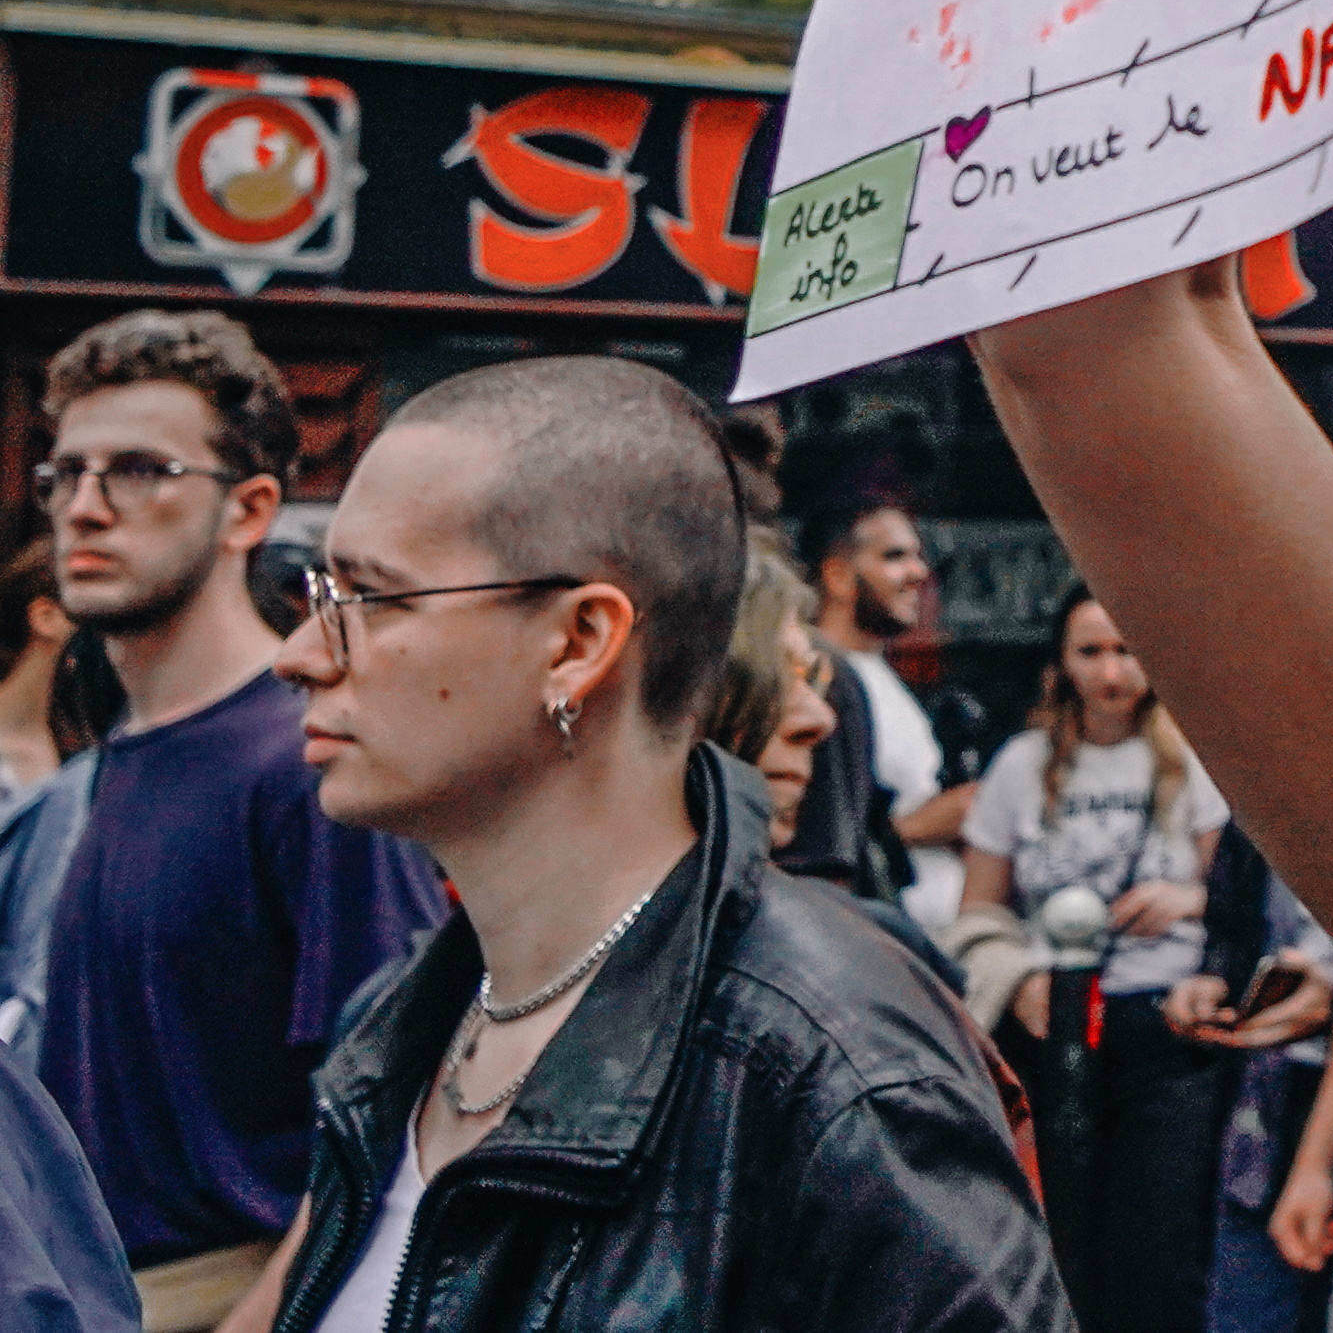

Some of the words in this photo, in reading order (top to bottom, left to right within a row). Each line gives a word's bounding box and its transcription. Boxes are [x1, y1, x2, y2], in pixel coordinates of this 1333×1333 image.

[951, 164, 1015, 208] On
[1031, 126, 1125, 184] veut
[1148, 94, 1210, 151] le
[784, 183, 883, 248] Alerte
[790, 232, 859, 302] info
